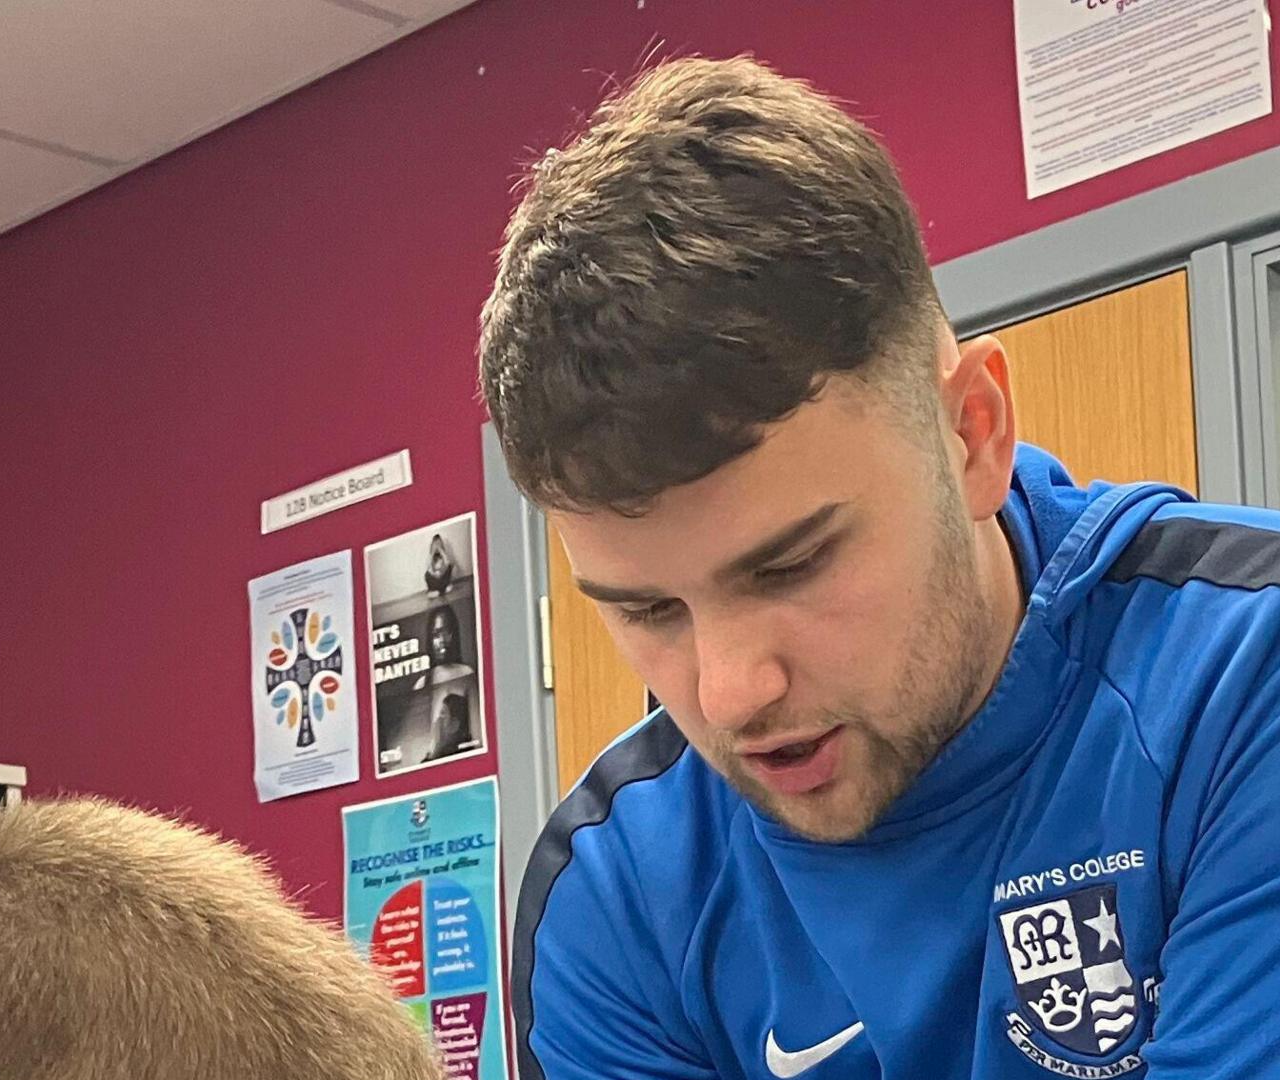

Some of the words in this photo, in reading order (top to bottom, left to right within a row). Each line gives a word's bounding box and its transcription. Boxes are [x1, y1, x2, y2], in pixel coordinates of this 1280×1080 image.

[348, 468, 384, 494] Board
[374, 654, 430, 685] BANTER
[351, 846, 419, 874] RECOGNISE
[422, 842, 445, 860] THE
[1018, 1039, 1047, 1065] PER
[1050, 1061, 1122, 1078] MARIAM
